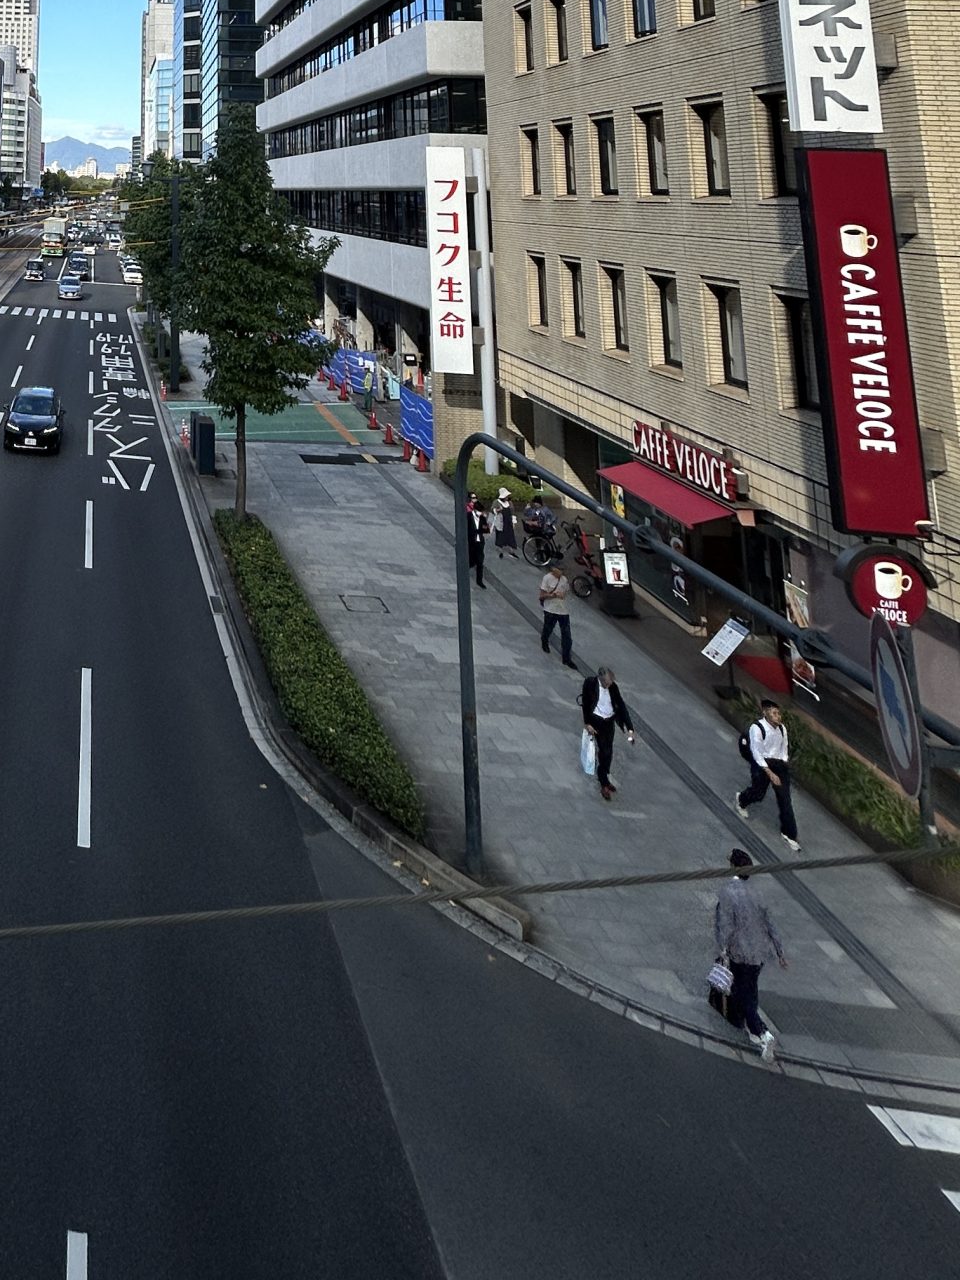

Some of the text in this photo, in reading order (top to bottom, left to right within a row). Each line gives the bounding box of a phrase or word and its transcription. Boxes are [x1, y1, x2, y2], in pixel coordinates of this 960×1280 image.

[434, 179, 466, 339] フコク生命
[100, 343, 132, 355] 7-9
[850, 351, 898, 455] VELOCE
[101, 433, 156, 492] バス
[672, 438, 731, 500] VELOCE
